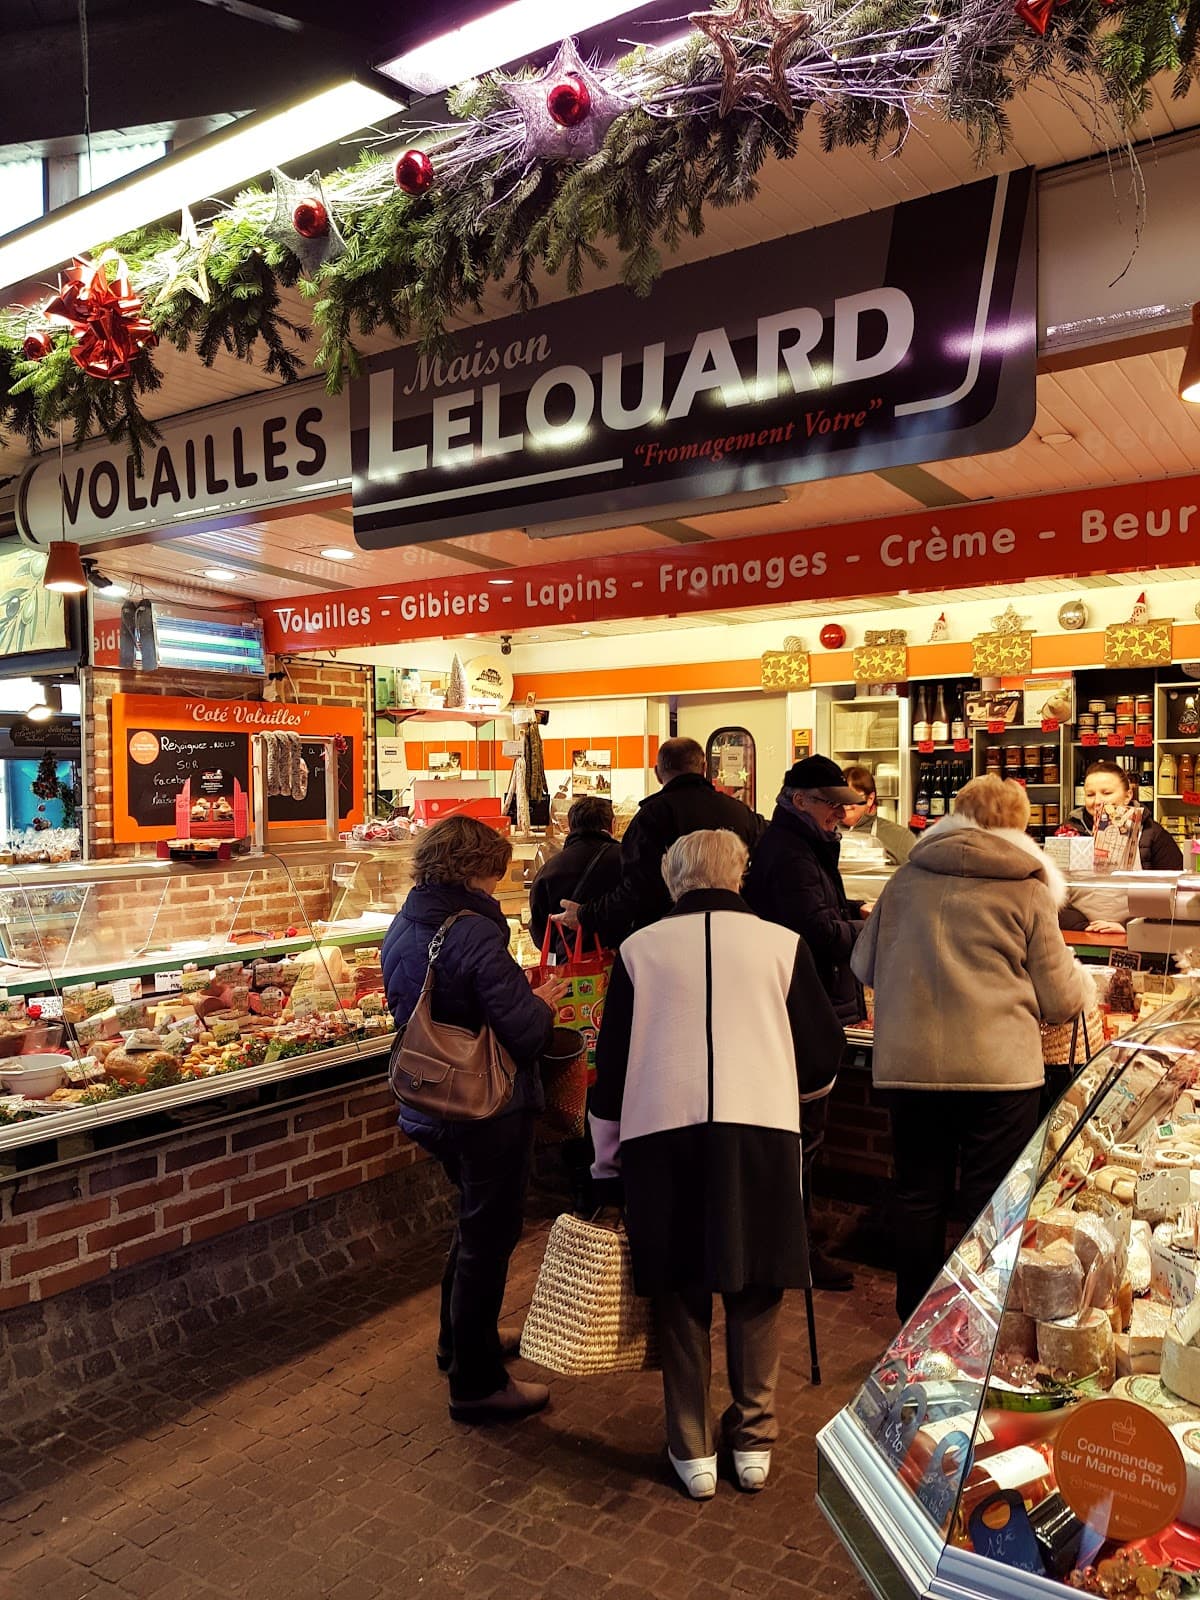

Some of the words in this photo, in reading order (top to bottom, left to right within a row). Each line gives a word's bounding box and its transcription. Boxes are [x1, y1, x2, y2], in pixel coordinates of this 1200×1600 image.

[368, 286, 916, 481] LELOUARD
[403, 333, 552, 396] Maison
[60, 406, 327, 525] VOLAILLES
[278, 605, 371, 634] Volailles
[401, 591, 490, 622] Gibiers
[526, 574, 618, 612] Lapins
[659, 550, 828, 595] Fromages
[879, 526, 1016, 568] Crème
[1060, 1450, 1082, 1465] sur
[1085, 1455, 1137, 1483] Marché
[1141, 1473, 1177, 1497] Privé
[1077, 1438, 1164, 1475] Commandez
